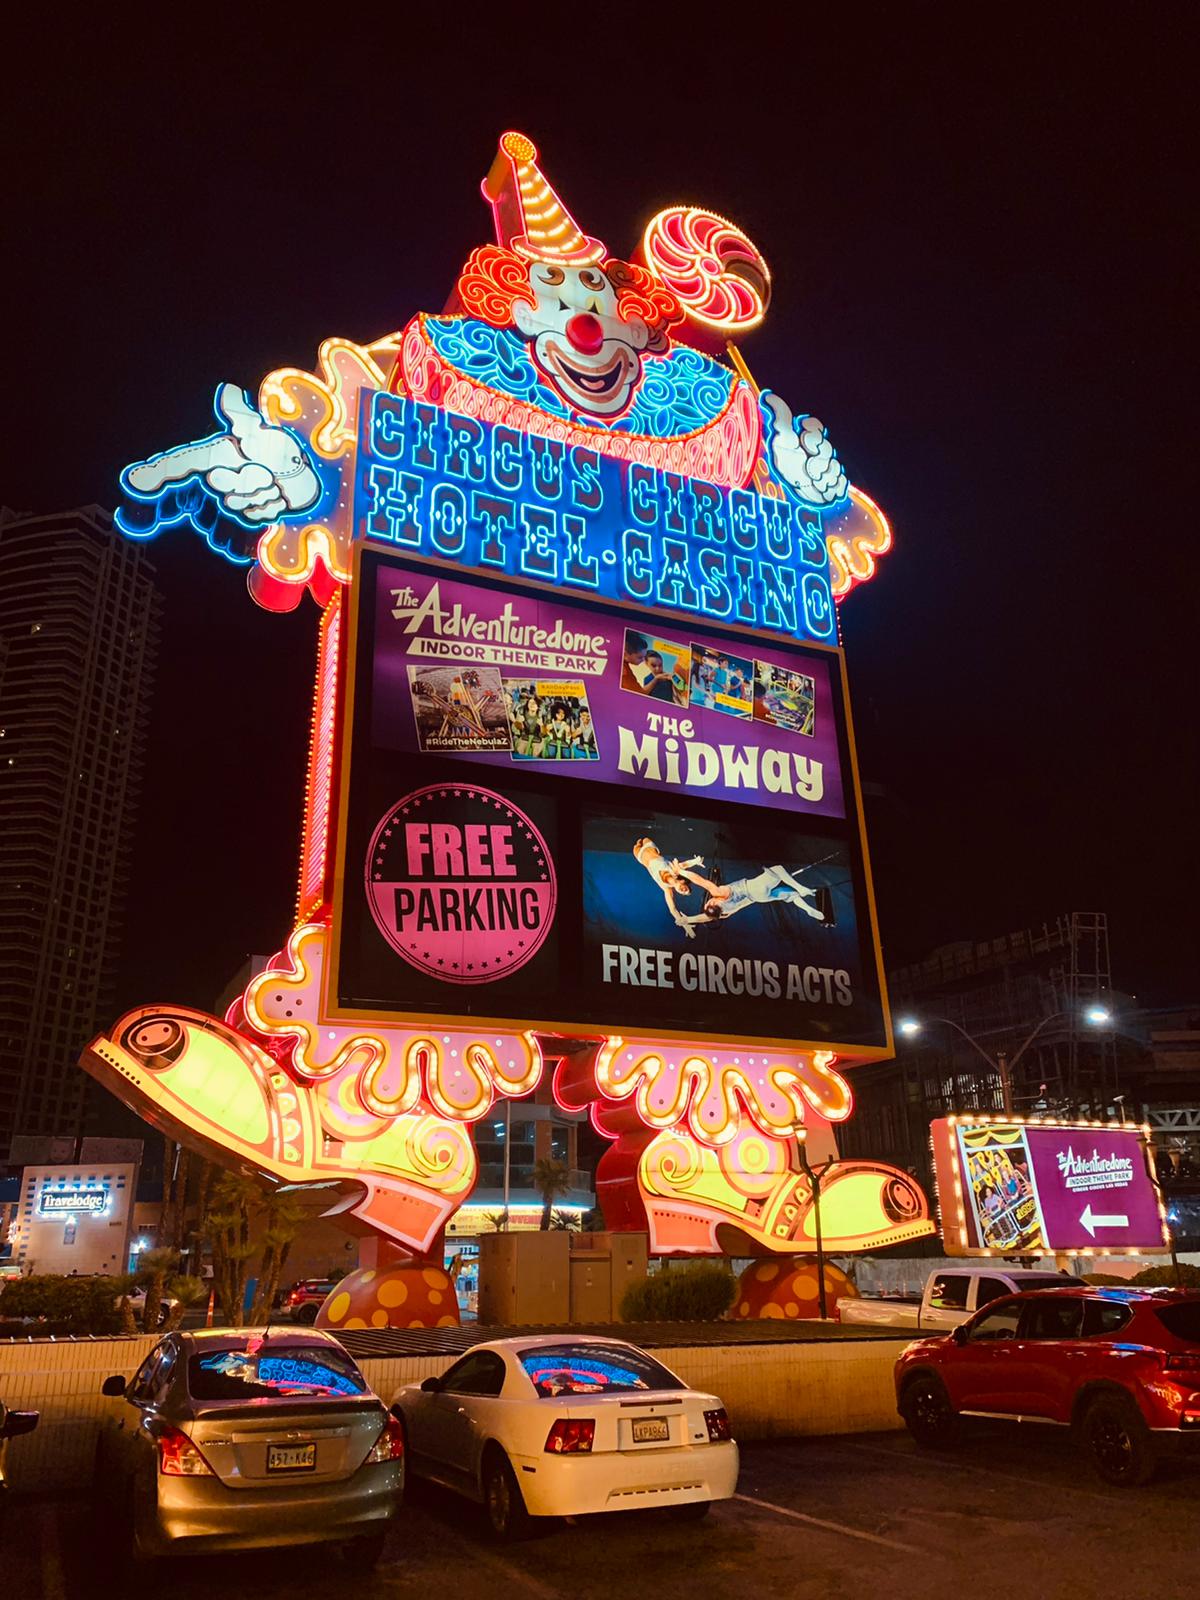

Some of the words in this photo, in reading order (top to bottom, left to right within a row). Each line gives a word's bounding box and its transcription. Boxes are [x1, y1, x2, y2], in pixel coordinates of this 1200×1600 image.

[370, 391, 603, 510] CIRCUS
[628, 462, 828, 568] CIRCUS
[367, 465, 600, 587] HOTEL
[621, 529, 834, 637] CASINO
[390, 586, 419, 607] The
[391, 581, 609, 655] Adventuredome
[420, 640, 485, 660] INDOOR
[491, 649, 550, 667] THEME
[555, 656, 597, 672] PARK
[426, 737, 508, 746] #RideTheNebulaZ
[405, 823, 517, 876] FREE
[394, 887, 541, 932] PARKING
[602, 943, 674, 989] FREE
[678, 952, 782, 999] CIRCUS
[786, 964, 853, 1007] ACTS
[1058, 1145, 1132, 1177] Adventuredome
[1069, 1177, 1092, 1185] INDOOR
[1092, 1174, 1113, 1182] THEME
[1114, 1172, 1130, 1180] PARK
[43, 1193, 103, 1209] Travelodge
